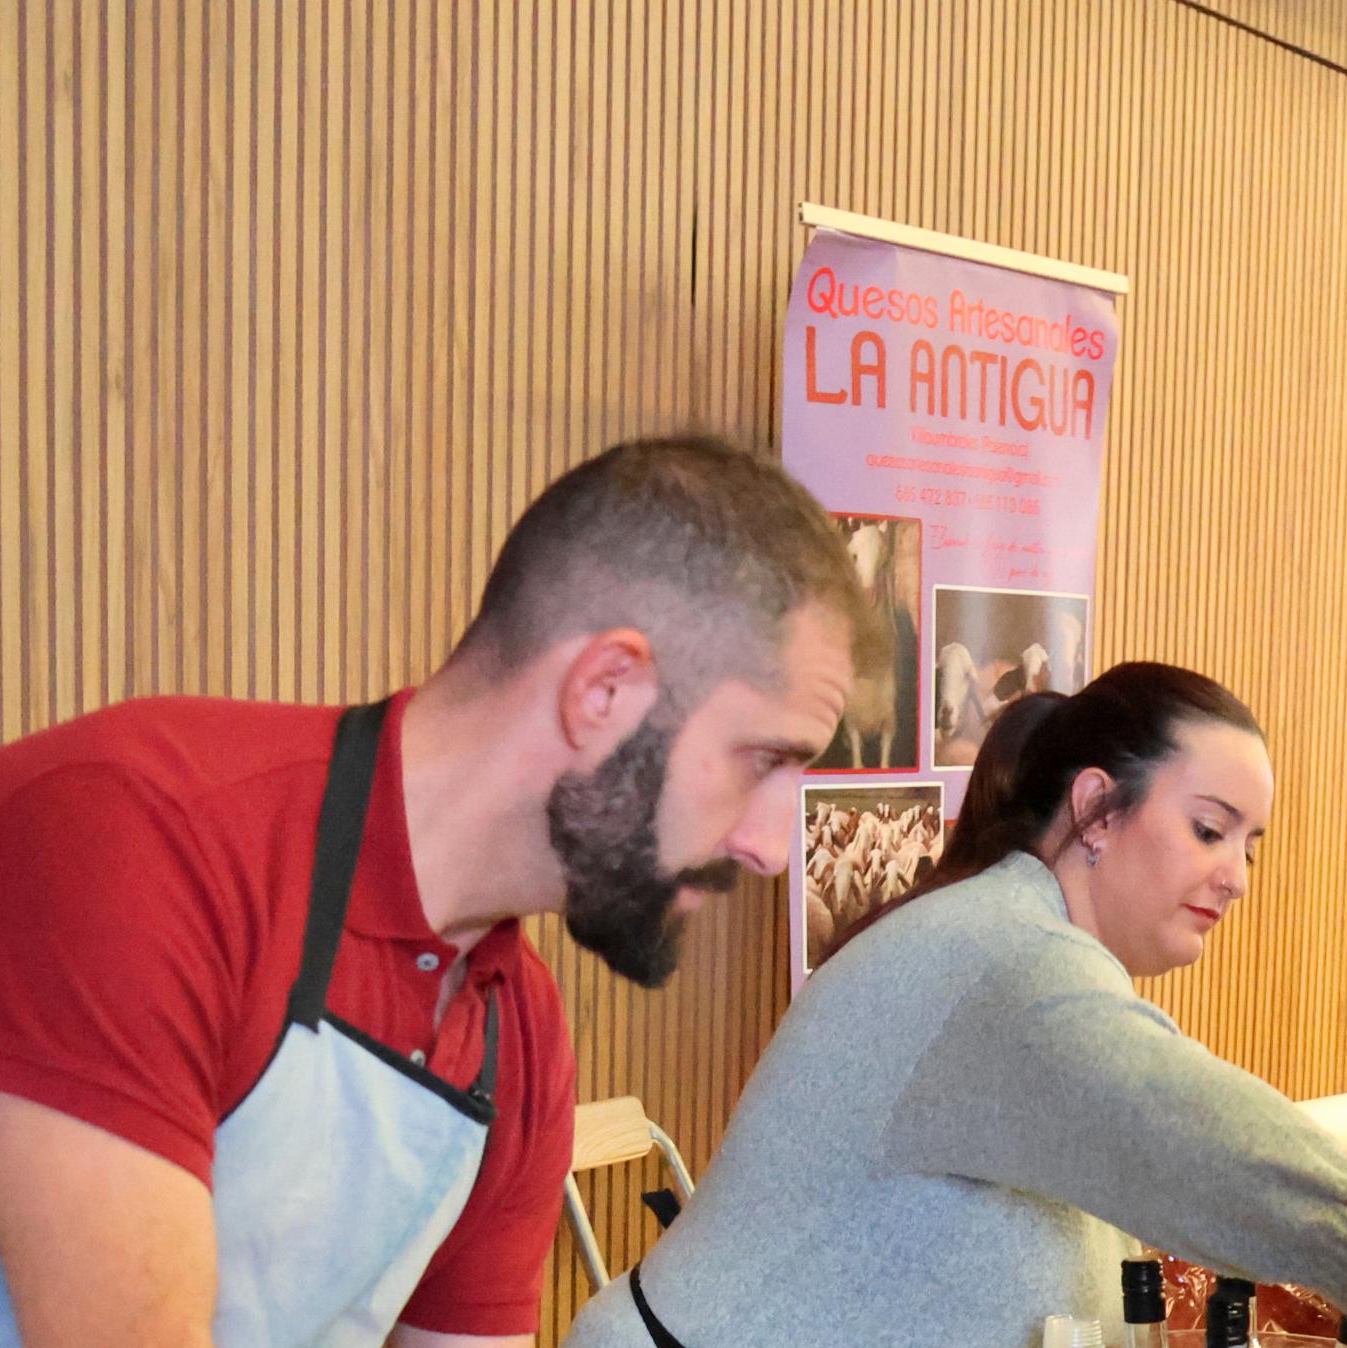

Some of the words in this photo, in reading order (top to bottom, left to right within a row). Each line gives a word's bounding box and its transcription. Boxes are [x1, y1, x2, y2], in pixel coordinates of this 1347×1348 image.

[807, 267, 939, 329] Quesos
[949, 290, 1105, 361] Artesanales
[805, 326, 886, 409] LA
[909, 339, 1095, 440] ANTIGUA
